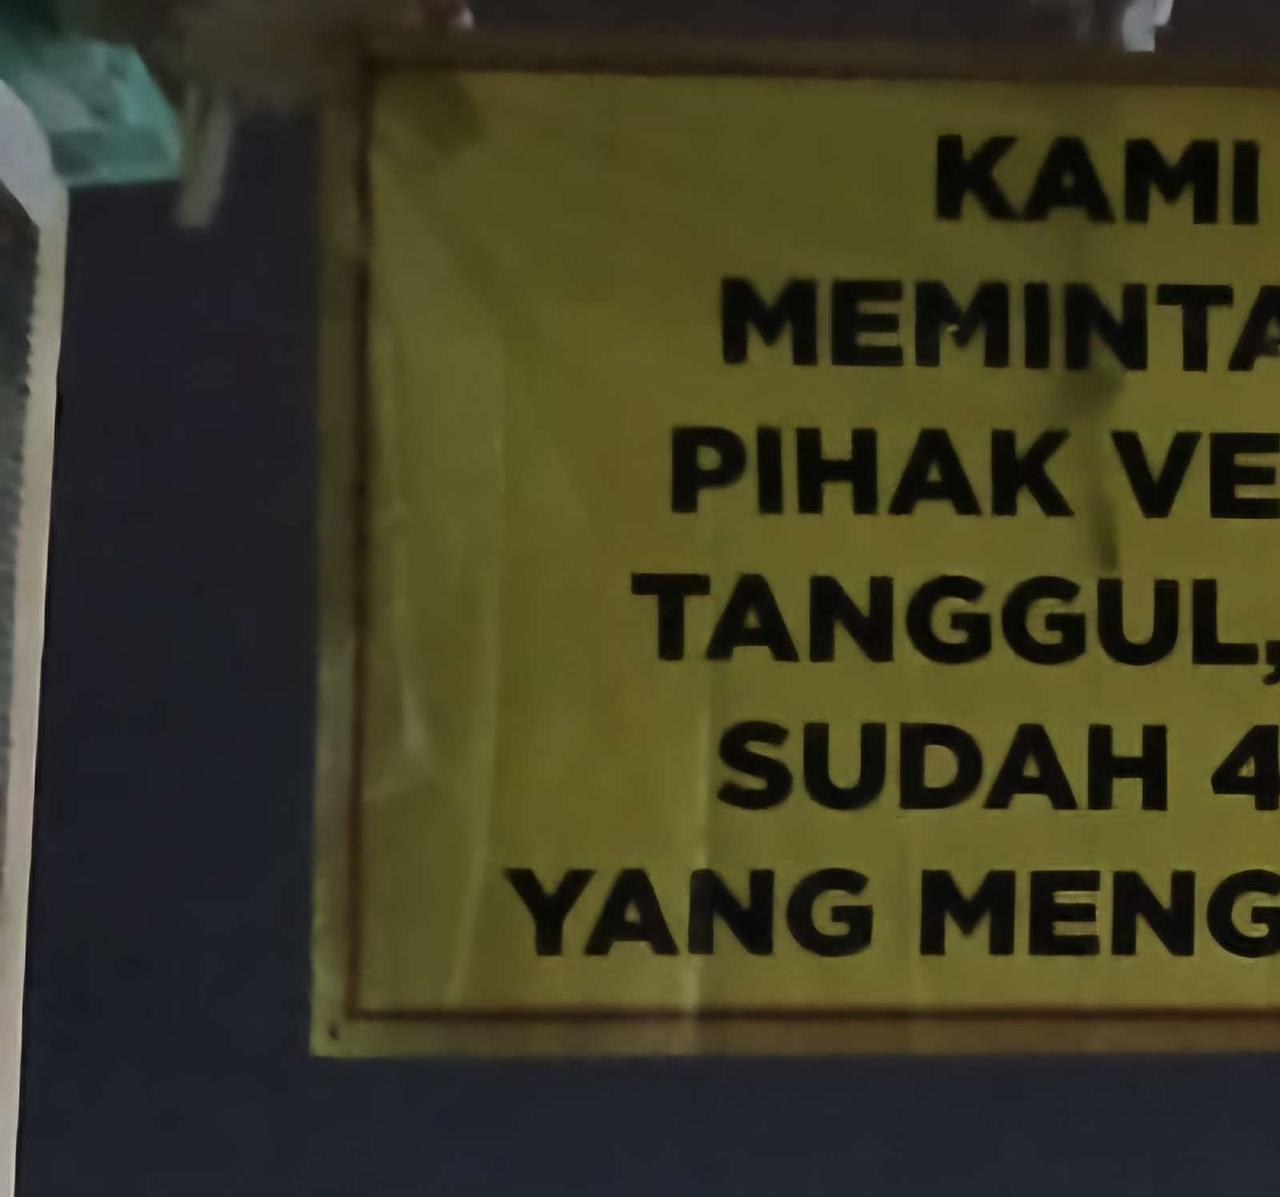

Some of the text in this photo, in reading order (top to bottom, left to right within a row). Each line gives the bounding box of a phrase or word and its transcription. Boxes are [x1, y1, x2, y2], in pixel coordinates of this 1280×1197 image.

[936, 135, 1259, 225] KAMI
[671, 426, 1075, 517] PIHAK
[716, 720, 1168, 812] SUDAH
[505, 867, 873, 957] YANG
